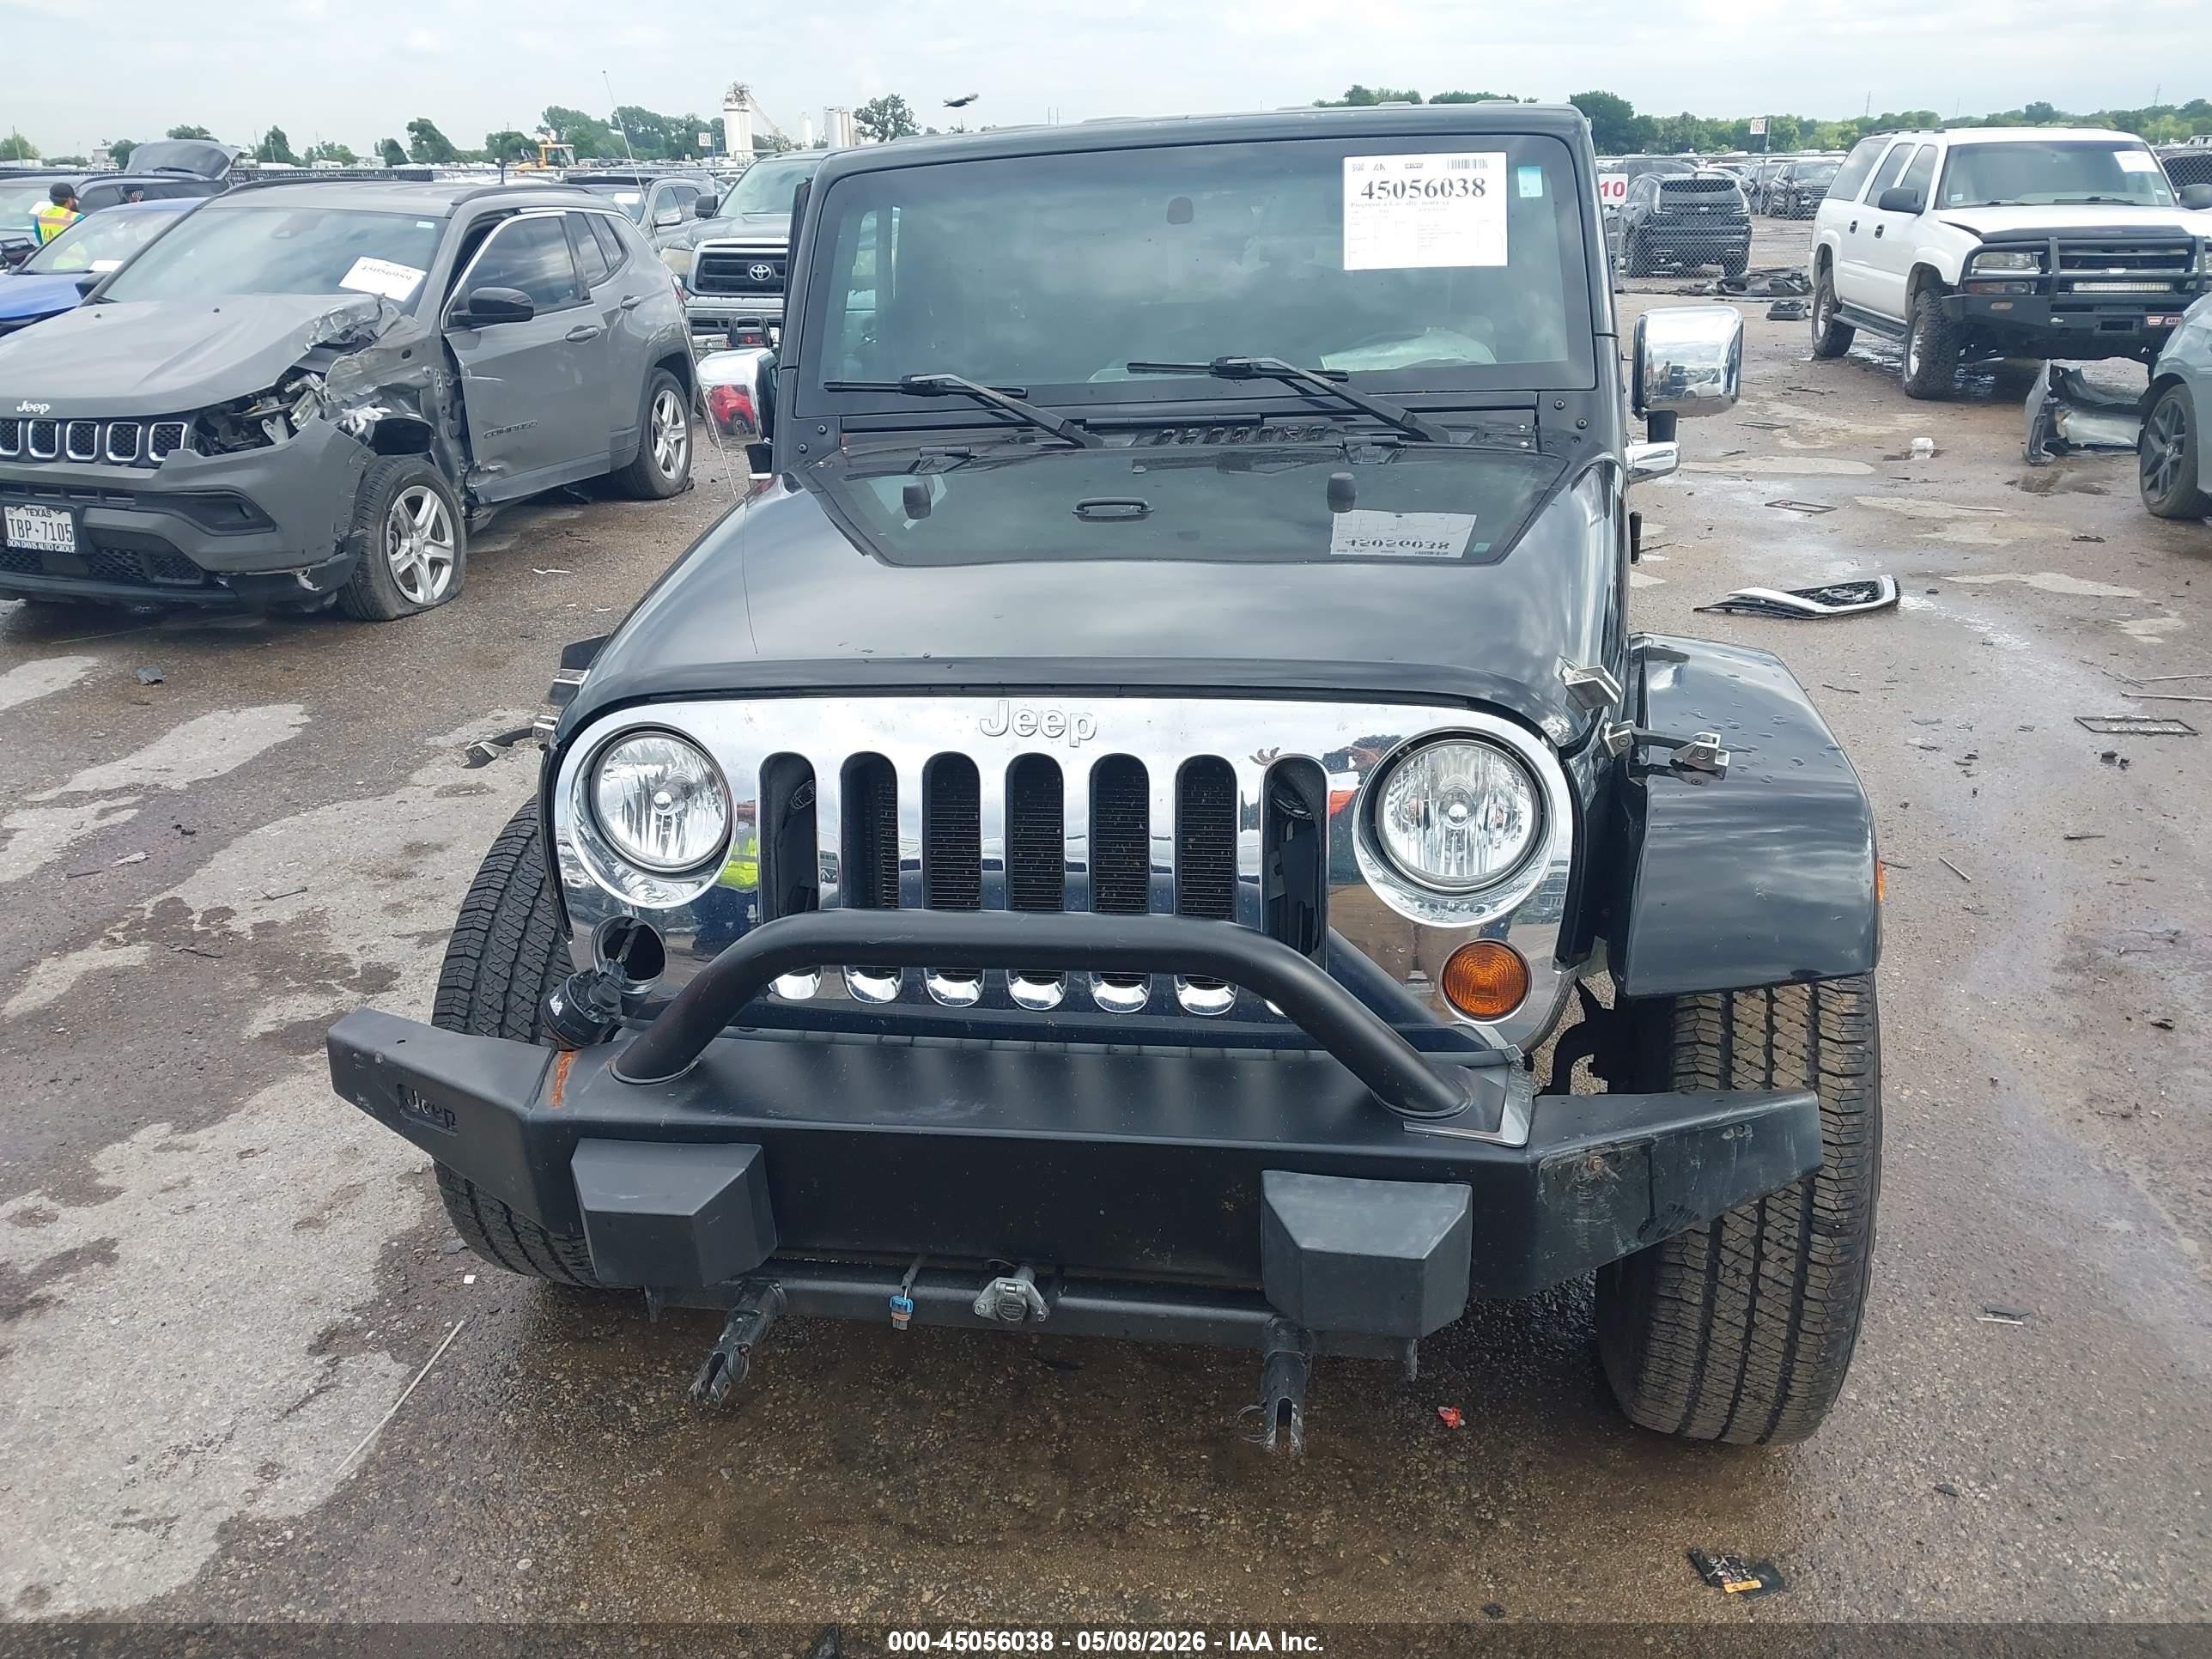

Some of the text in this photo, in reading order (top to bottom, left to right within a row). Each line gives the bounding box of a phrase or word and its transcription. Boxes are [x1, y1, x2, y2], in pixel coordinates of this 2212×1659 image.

[1752, 120, 1764, 132] 160
[700, 133, 710, 145] 150
[1360, 177, 1486, 200] 45056038
[1600, 181, 1626, 198] 10
[16, 400, 50, 415] Jeep
[25, 508, 52, 518] TEXAS
[7, 539, 76, 553] DON DAVIS AUTO GROUP
[979, 700, 1097, 748] Jeep
[406, 1090, 457, 1128] Jeep
